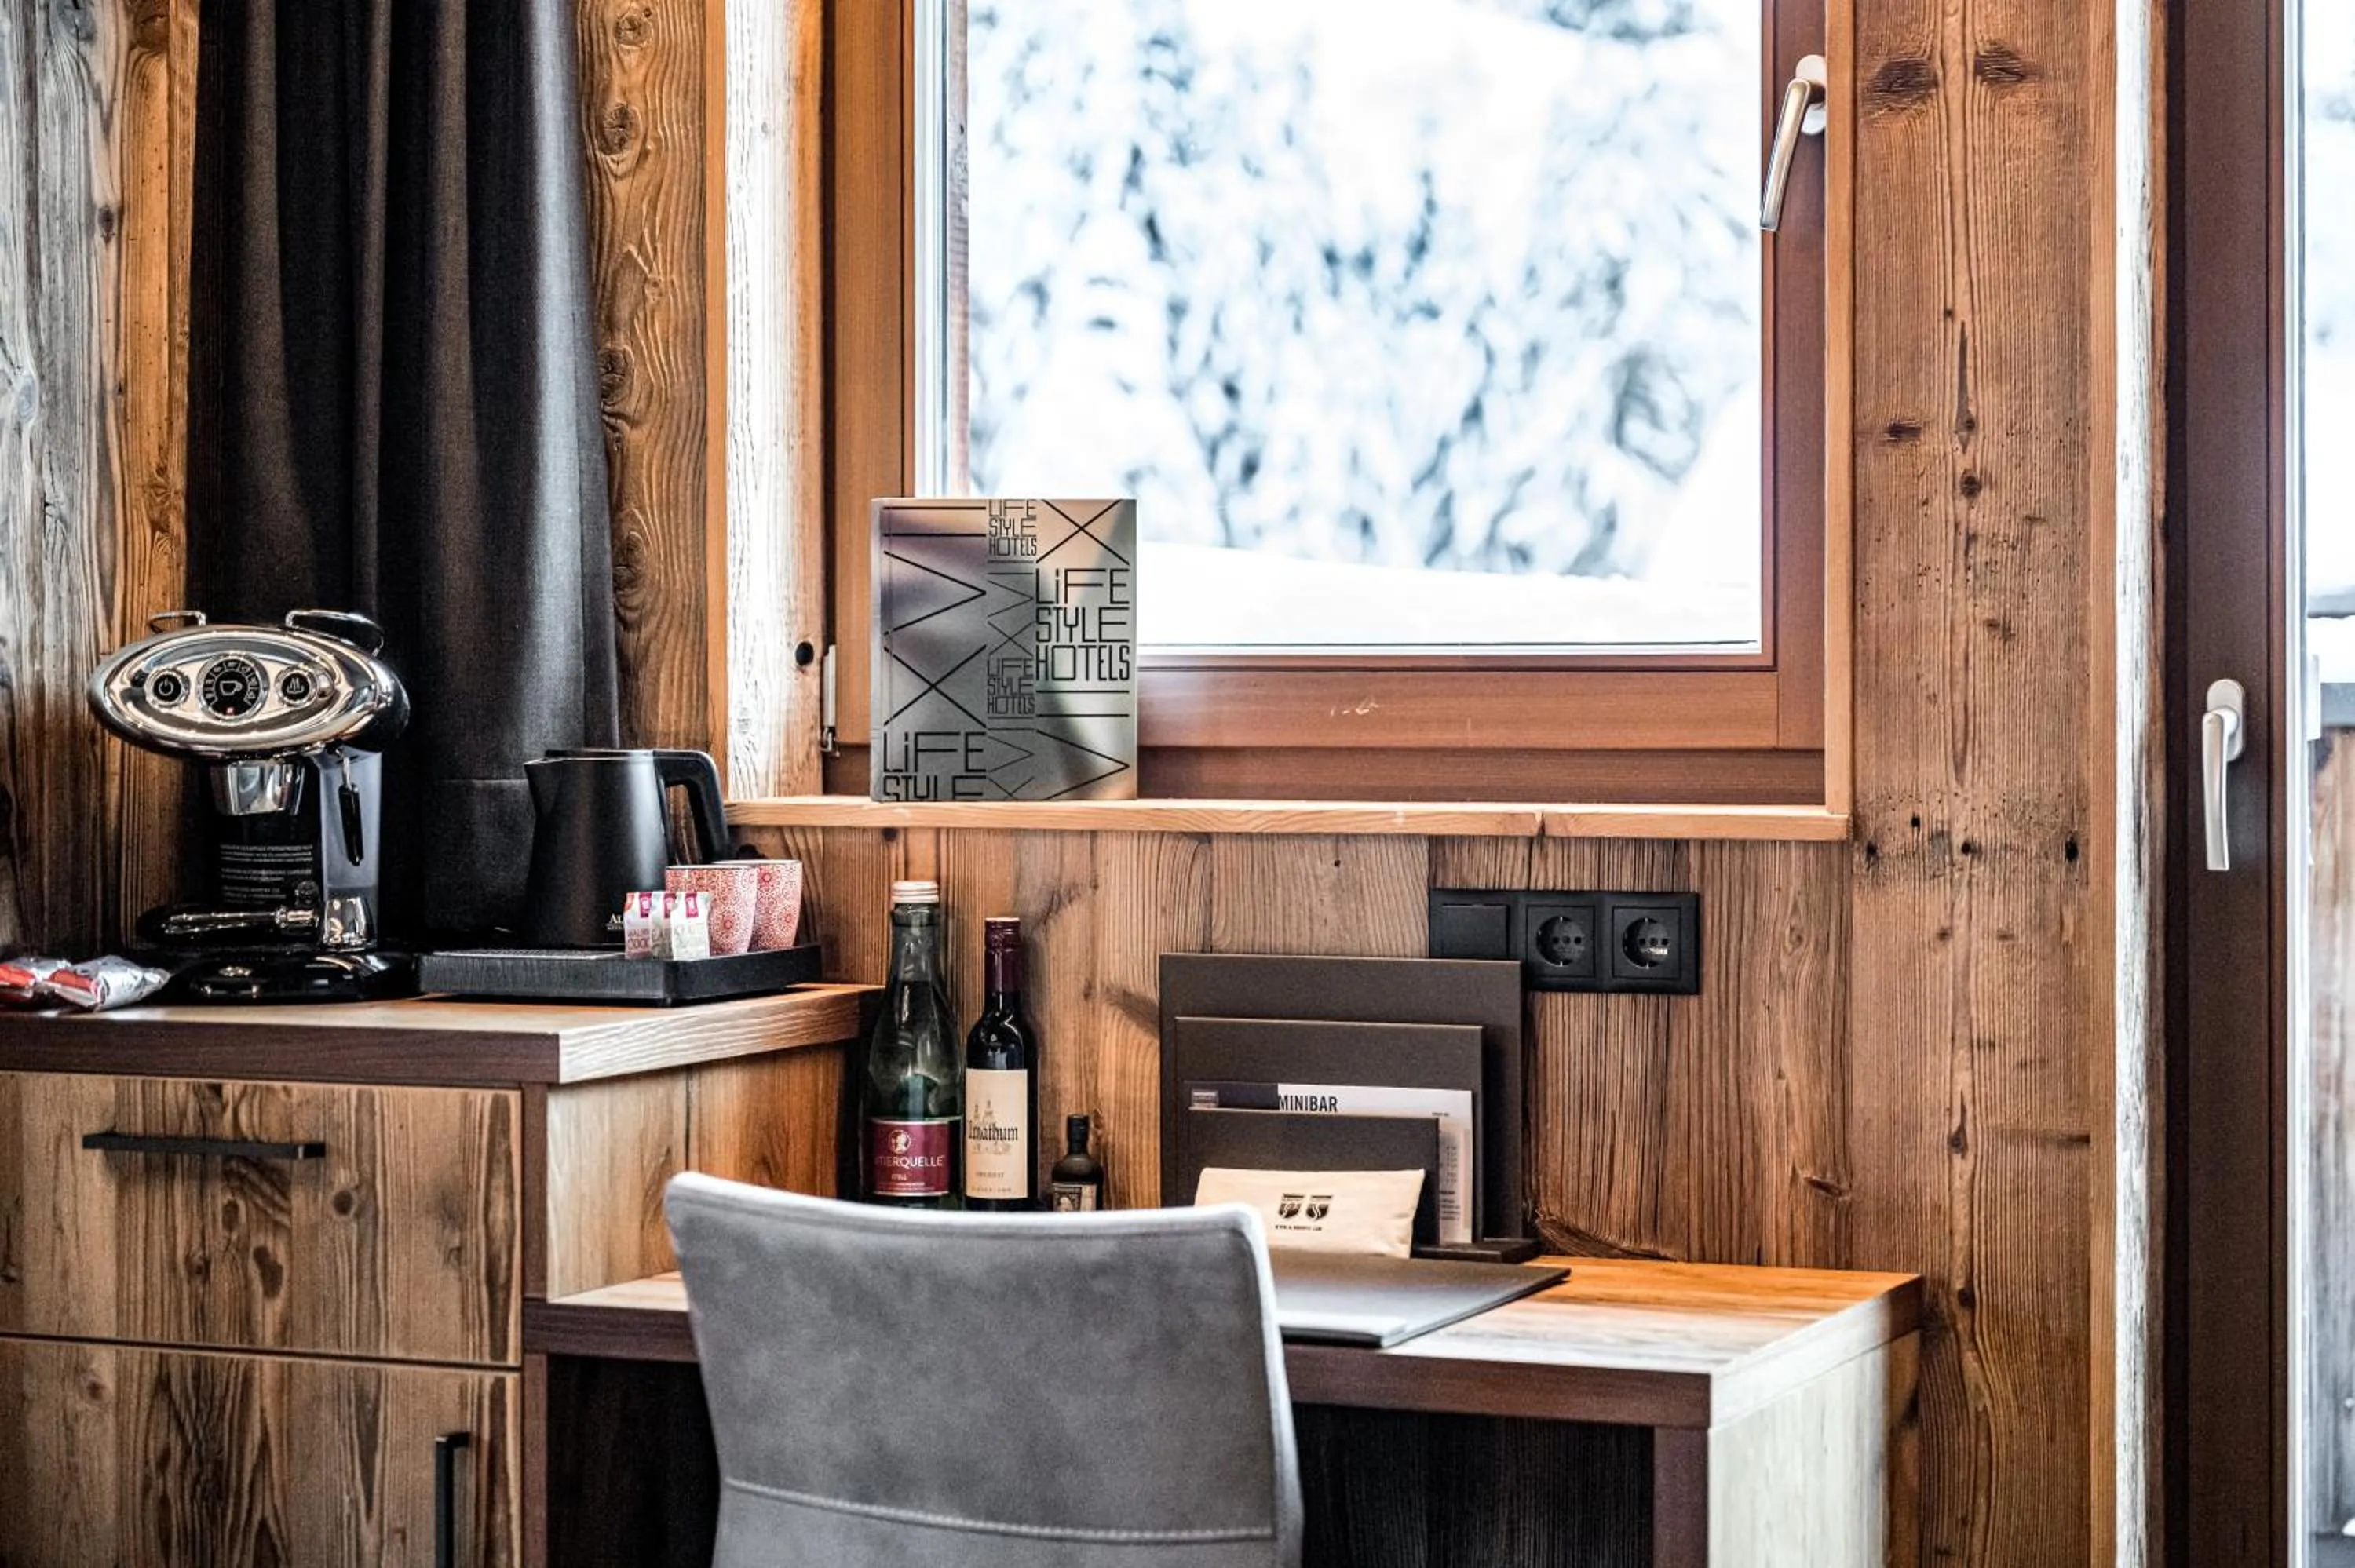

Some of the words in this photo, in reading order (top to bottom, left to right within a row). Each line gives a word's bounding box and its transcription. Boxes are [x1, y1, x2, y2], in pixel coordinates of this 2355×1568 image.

[989, 517, 1037, 538] STYLE
[989, 536, 1037, 556] HOTELS
[1036, 607, 1130, 643] STYLE
[1036, 644, 1130, 681] HOTELS
[987, 676, 1034, 696] STYLE
[987, 695, 1035, 714] HOTELS
[1279, 1095, 1338, 1112] MINIBAR
